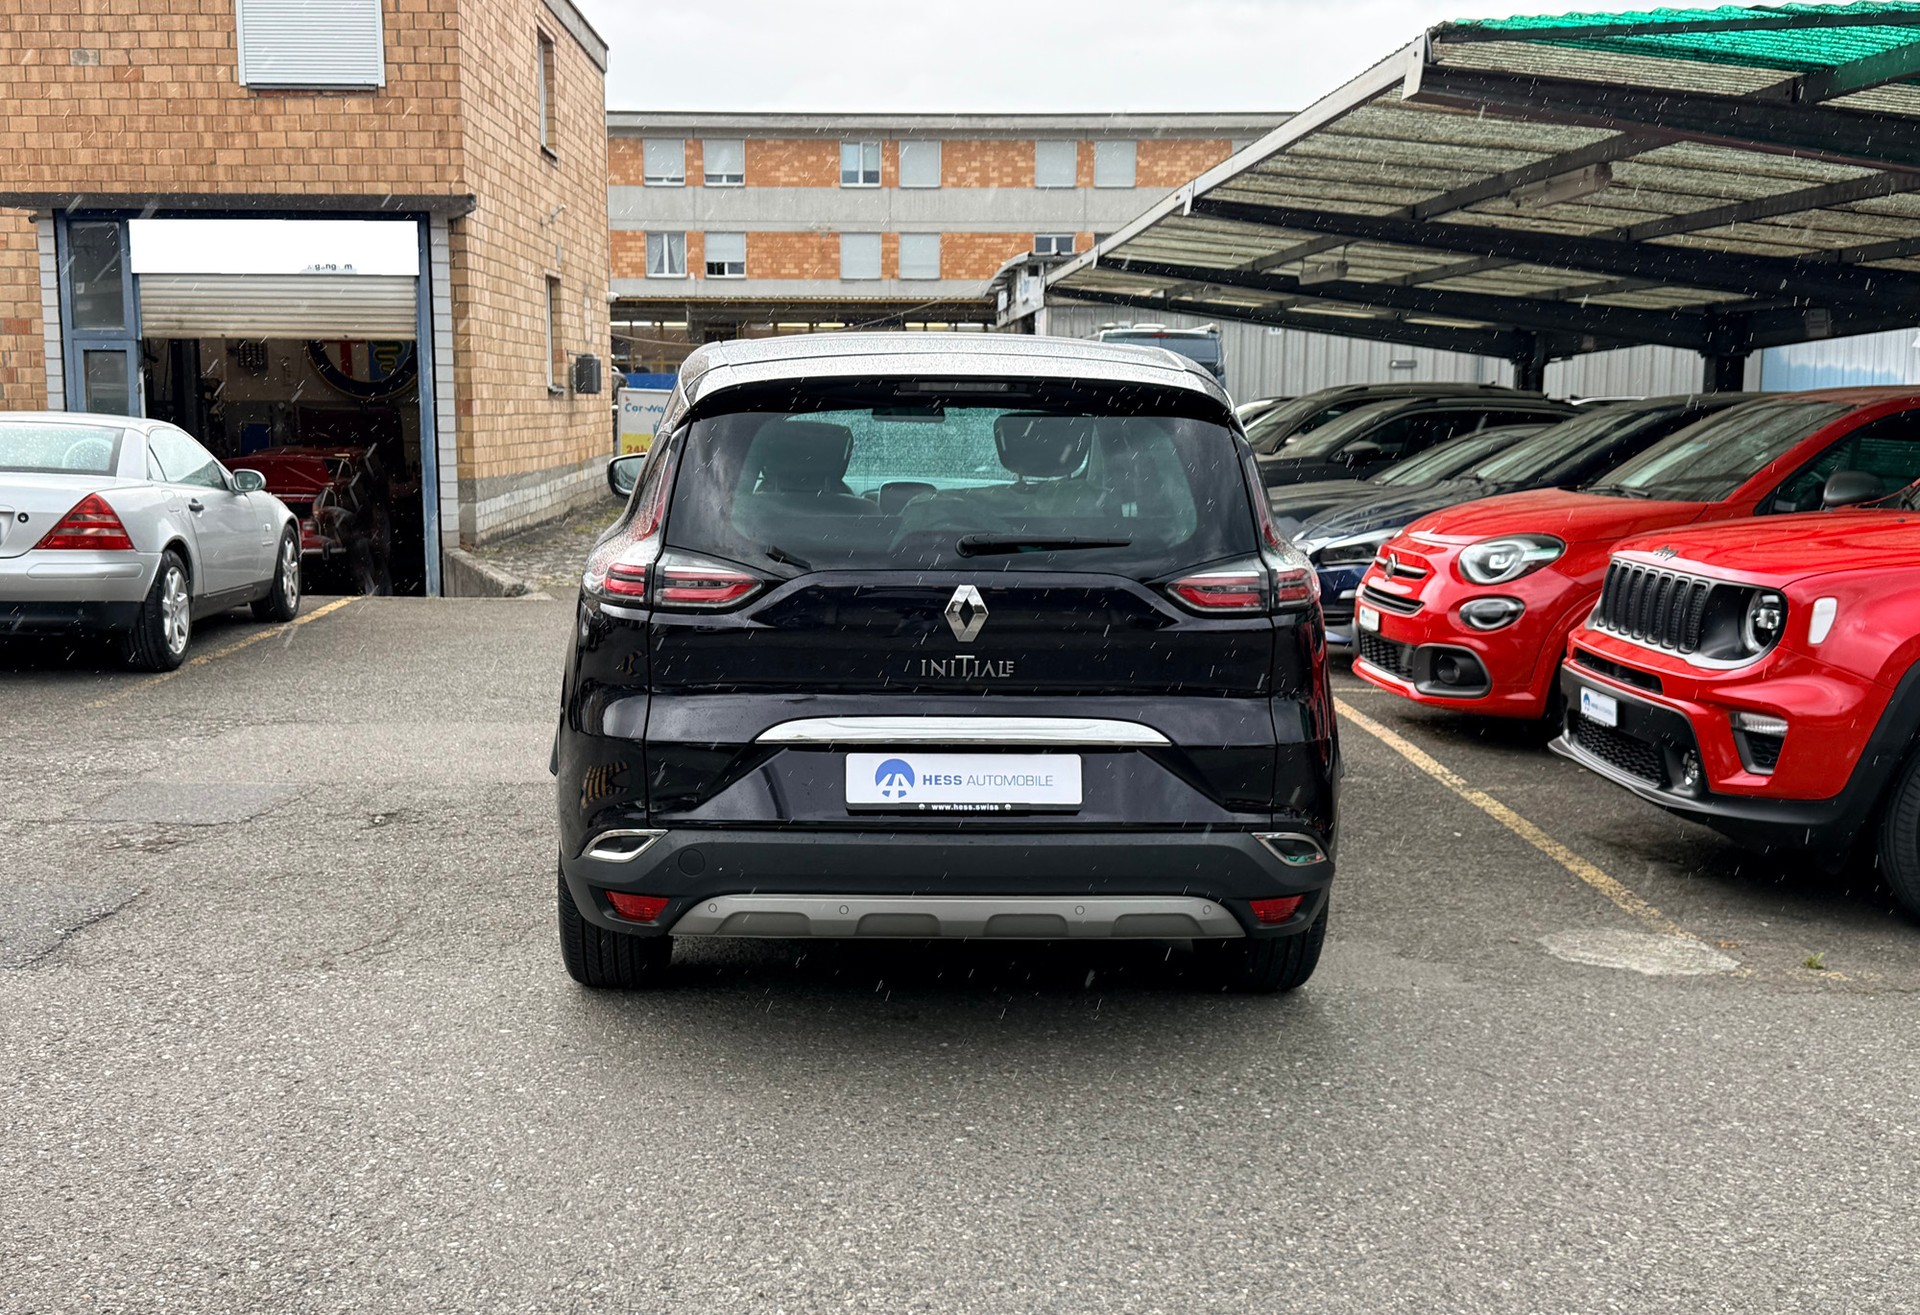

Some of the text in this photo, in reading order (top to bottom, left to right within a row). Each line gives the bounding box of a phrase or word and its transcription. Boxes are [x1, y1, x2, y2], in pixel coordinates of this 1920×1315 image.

[624, 402, 664, 413] Car-Wa
[921, 654, 1015, 678] INITIALE
[922, 774, 1054, 787] HESS AUTOMOBILE
